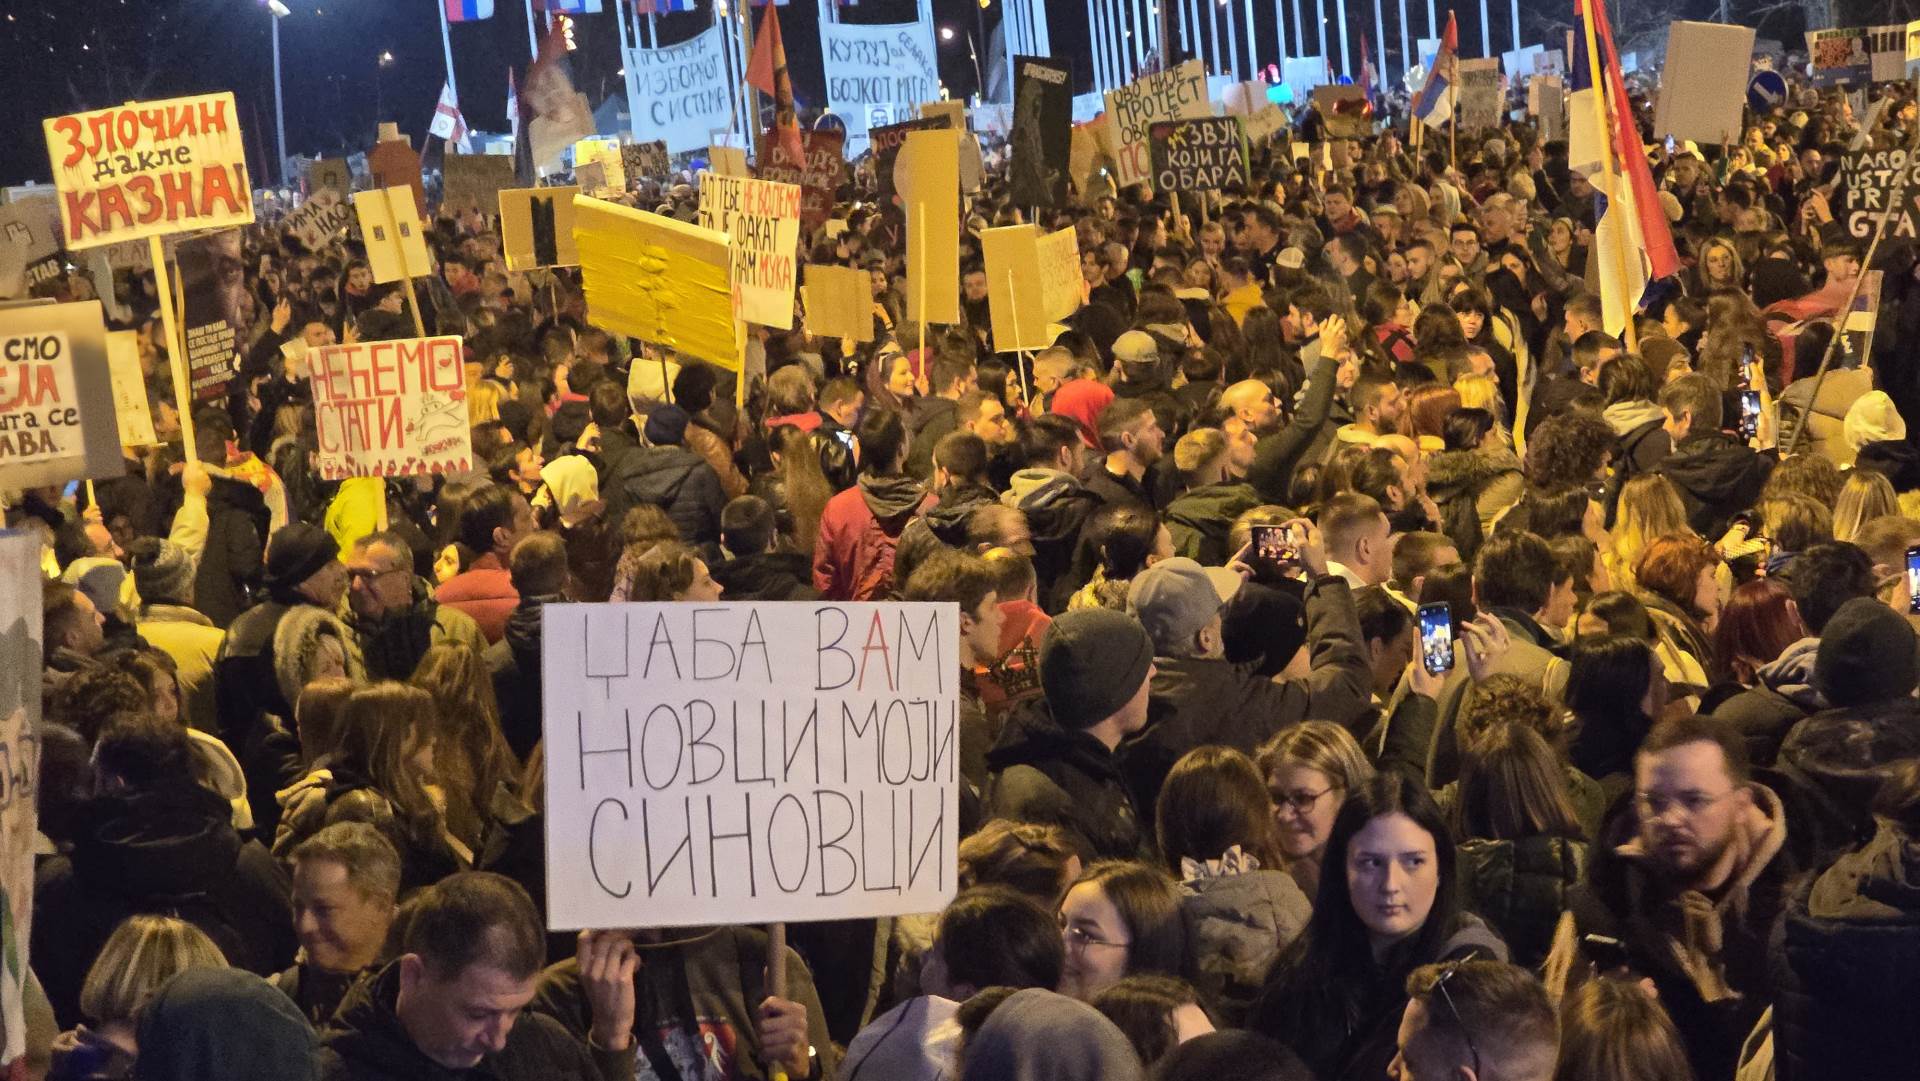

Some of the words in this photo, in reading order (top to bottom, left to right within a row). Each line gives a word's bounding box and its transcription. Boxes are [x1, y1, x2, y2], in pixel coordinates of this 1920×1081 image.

[830, 77, 892, 104] БОЈКОТ
[1113, 83, 1141, 105] ОВО
[1115, 75, 1200, 128] ПРОТЕСТ
[53, 100, 227, 168] ЗЛОЧИН
[1186, 119, 1241, 146] ЗВУК
[92, 145, 193, 182] дакле
[1167, 147, 1213, 169] КОЈИ
[1218, 146, 1243, 166] ГА
[1160, 166, 1244, 191] ОБАРА
[1847, 187, 1905, 210] PRE
[64, 162, 249, 241] КАЗНА!
[736, 213, 780, 253] ФАКАТ
[1848, 210, 1917, 240] GTA
[734, 249, 757, 286] НАМ
[758, 254, 793, 291] МУКА
[307, 338, 464, 402] НЕЋЕМО
[48, 407, 81, 427] се
[319, 395, 404, 453] СТАТИ
[585, 607, 772, 699] ЏАБА
[815, 606, 942, 694] ВАМ
[578, 698, 819, 790] НОВЦИ
[842, 696, 955, 786] МОЈИ
[589, 786, 945, 898] СИНОВЦИ
